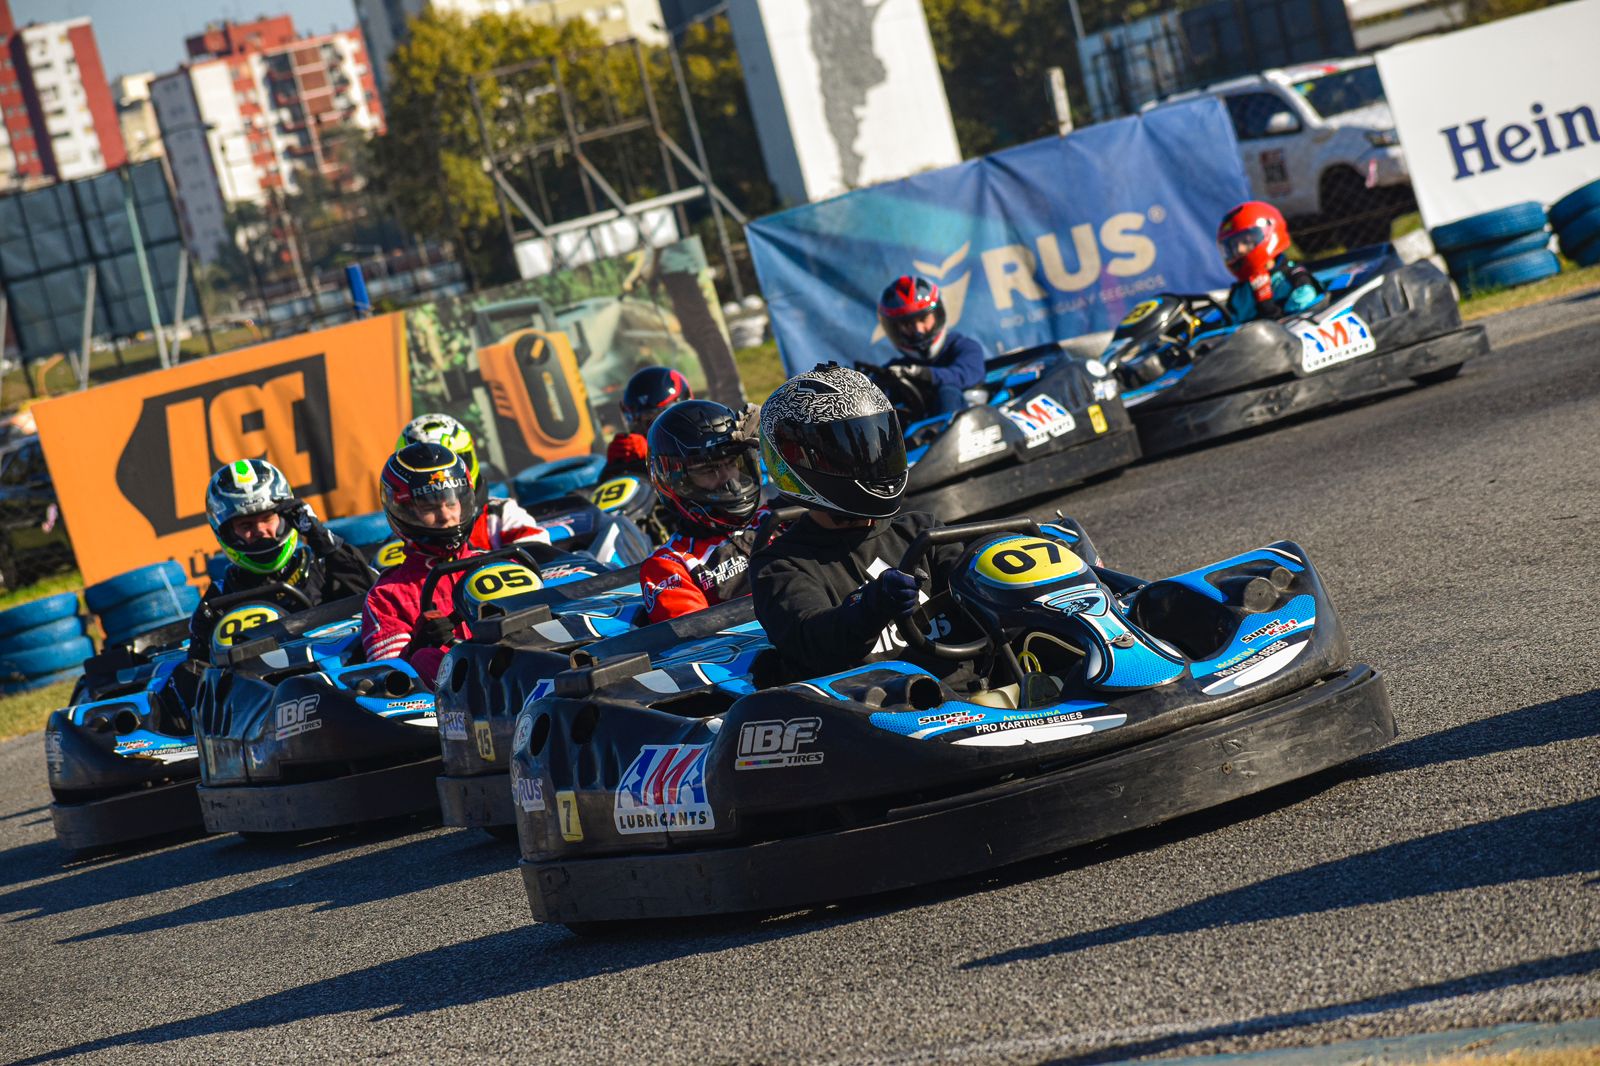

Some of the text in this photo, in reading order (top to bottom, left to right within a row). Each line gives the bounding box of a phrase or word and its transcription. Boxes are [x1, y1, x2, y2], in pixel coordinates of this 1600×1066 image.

[1439, 103, 1600, 180] Hein
[412, 477, 468, 497] RENAULT
[594, 483, 626, 505] 19
[698, 556, 749, 583] ESCUELA
[992, 542, 1062, 575] 07
[475, 569, 533, 595] 05
[702, 562, 750, 591] DE PILOTOS
[1241, 619, 1280, 643] Super
[1268, 619, 1298, 636] Kart
[277, 695, 320, 728] IBF
[919, 710, 970, 725] Super
[946, 713, 986, 725] Kart
[975, 711, 1083, 734] PRO KARTING SERIES
[1003, 709, 1061, 721] ARGENTINA
[301, 720, 321, 731] TIRES
[739, 718, 821, 756] IBF
[786, 753, 822, 764] TIRES
[618, 748, 707, 809] AMA
[562, 800, 572, 833] 7
[619, 811, 708, 829] LUBRICANTS
